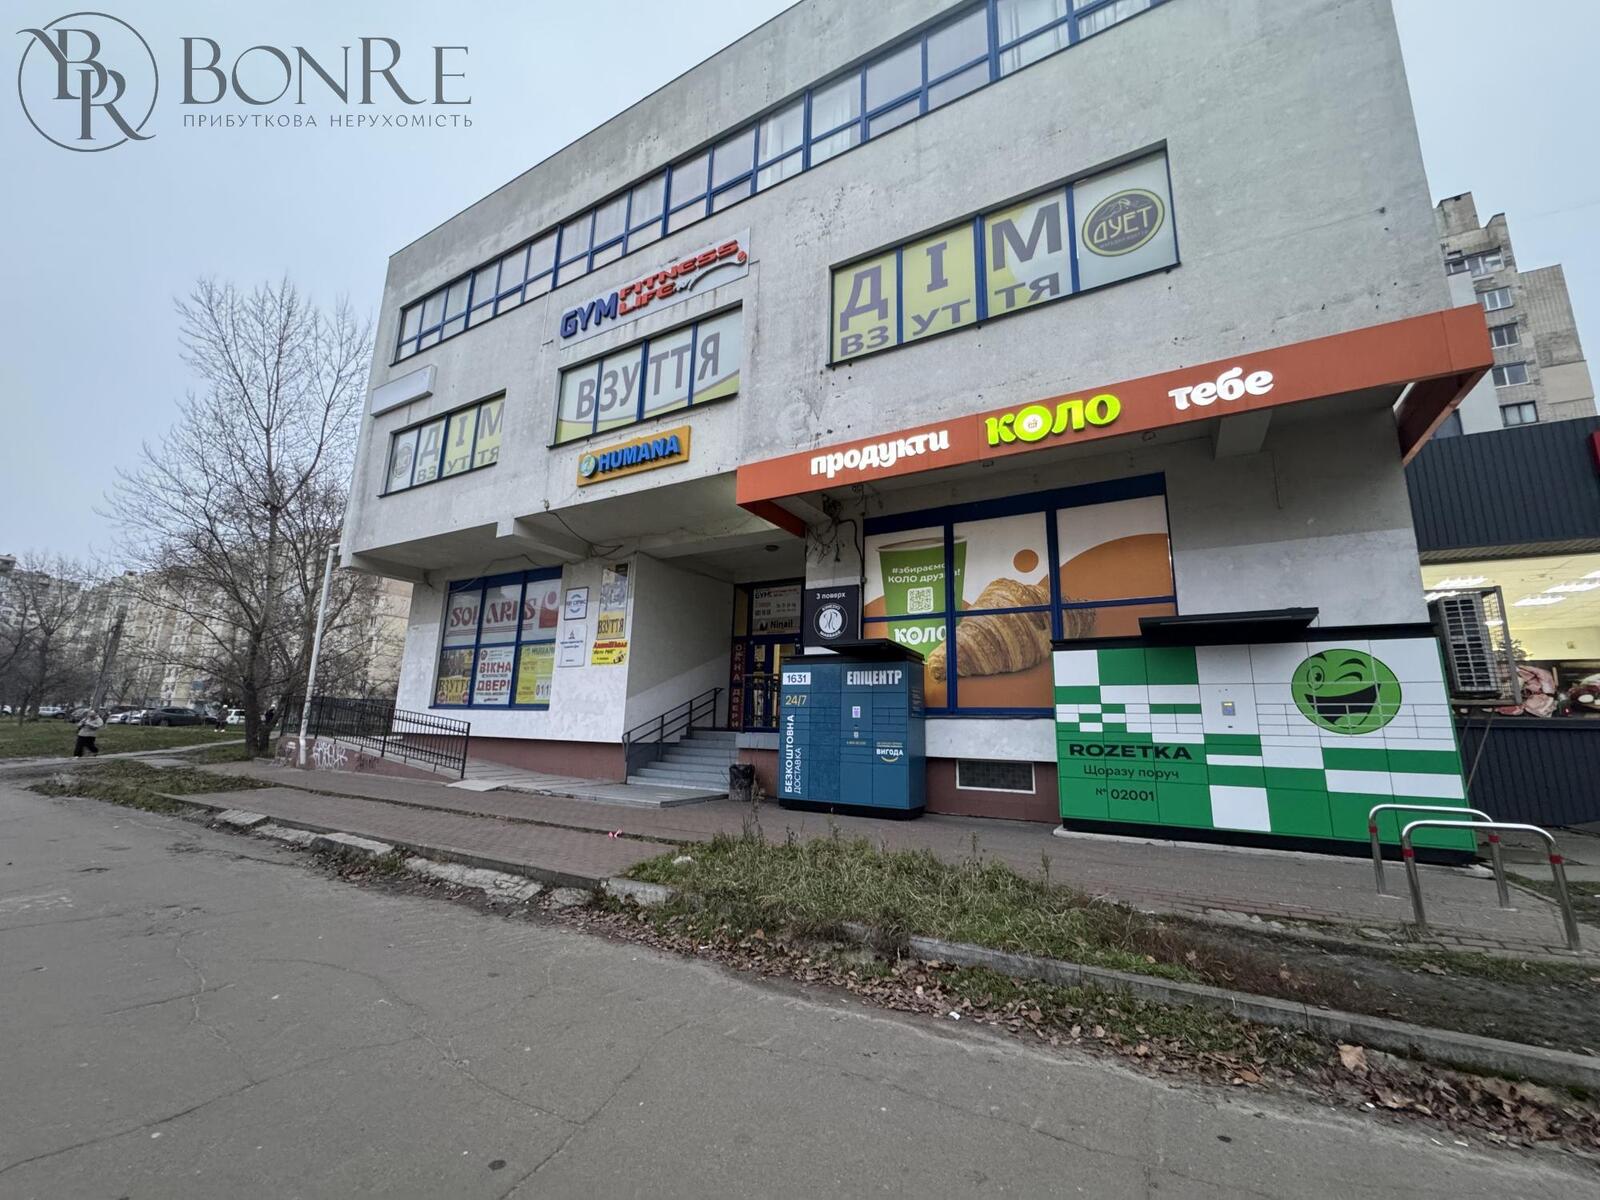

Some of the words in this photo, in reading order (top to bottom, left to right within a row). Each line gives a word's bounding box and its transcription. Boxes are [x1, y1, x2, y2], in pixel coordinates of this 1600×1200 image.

[1093, 206, 1153, 244] ДУЕТ
[840, 202, 1063, 332] ДІМ
[560, 291, 619, 339] GYM
[618, 281, 677, 316] LIFE
[840, 272, 1060, 357] ВЗУТТЯ
[575, 332, 721, 420] ВЗУТТЯ
[418, 401, 504, 467] ДІМ
[810, 428, 950, 479] продукти
[1167, 366, 1275, 412] тебе
[417, 446, 500, 482] ВЗУТТЯ
[598, 434, 682, 473] HUMANA
[821, 591, 846, 600] поверх
[597, 618, 625, 634] ВЗУТТЯ
[479, 661, 512, 674] ВІКНА
[786, 673, 807, 684] 1631
[846, 670, 902, 687] ЕПІЦЕНТР
[476, 679, 511, 692] ДВЕРІ
[785, 695, 807, 706] 24/7
[784, 714, 795, 794] БЕЗКОШТОВНА
[876, 748, 904, 756] ВИГОДА
[1069, 743, 1193, 761] ROZETKA
[793, 747, 802, 794] ДОСТАВКА
[1083, 764, 1135, 779] Щоразу
[1138, 767, 1180, 782] поруч
[1110, 788, 1155, 802] 02001
